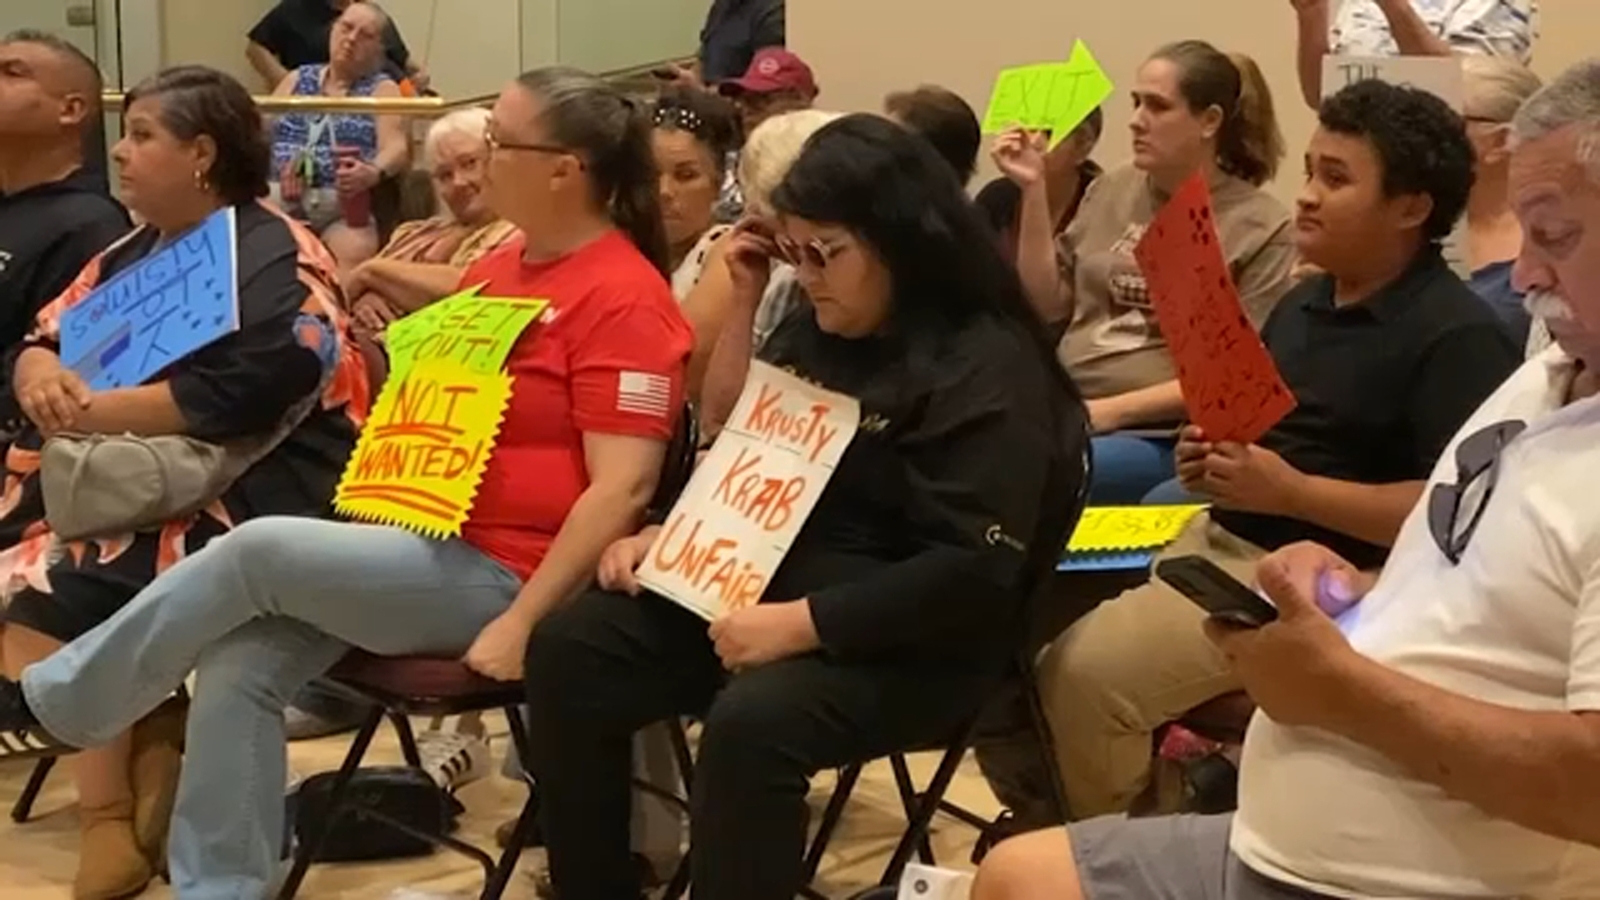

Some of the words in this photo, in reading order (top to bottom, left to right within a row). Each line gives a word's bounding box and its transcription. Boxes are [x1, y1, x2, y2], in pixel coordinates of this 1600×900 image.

[992, 69, 1097, 119] EXIT
[439, 300, 538, 335] GET
[411, 331, 501, 369] OUT!
[388, 377, 479, 427] NOT
[745, 383, 839, 464] KRUSTY
[354, 439, 484, 481] WANTED!
[711, 446, 806, 532] KRAB
